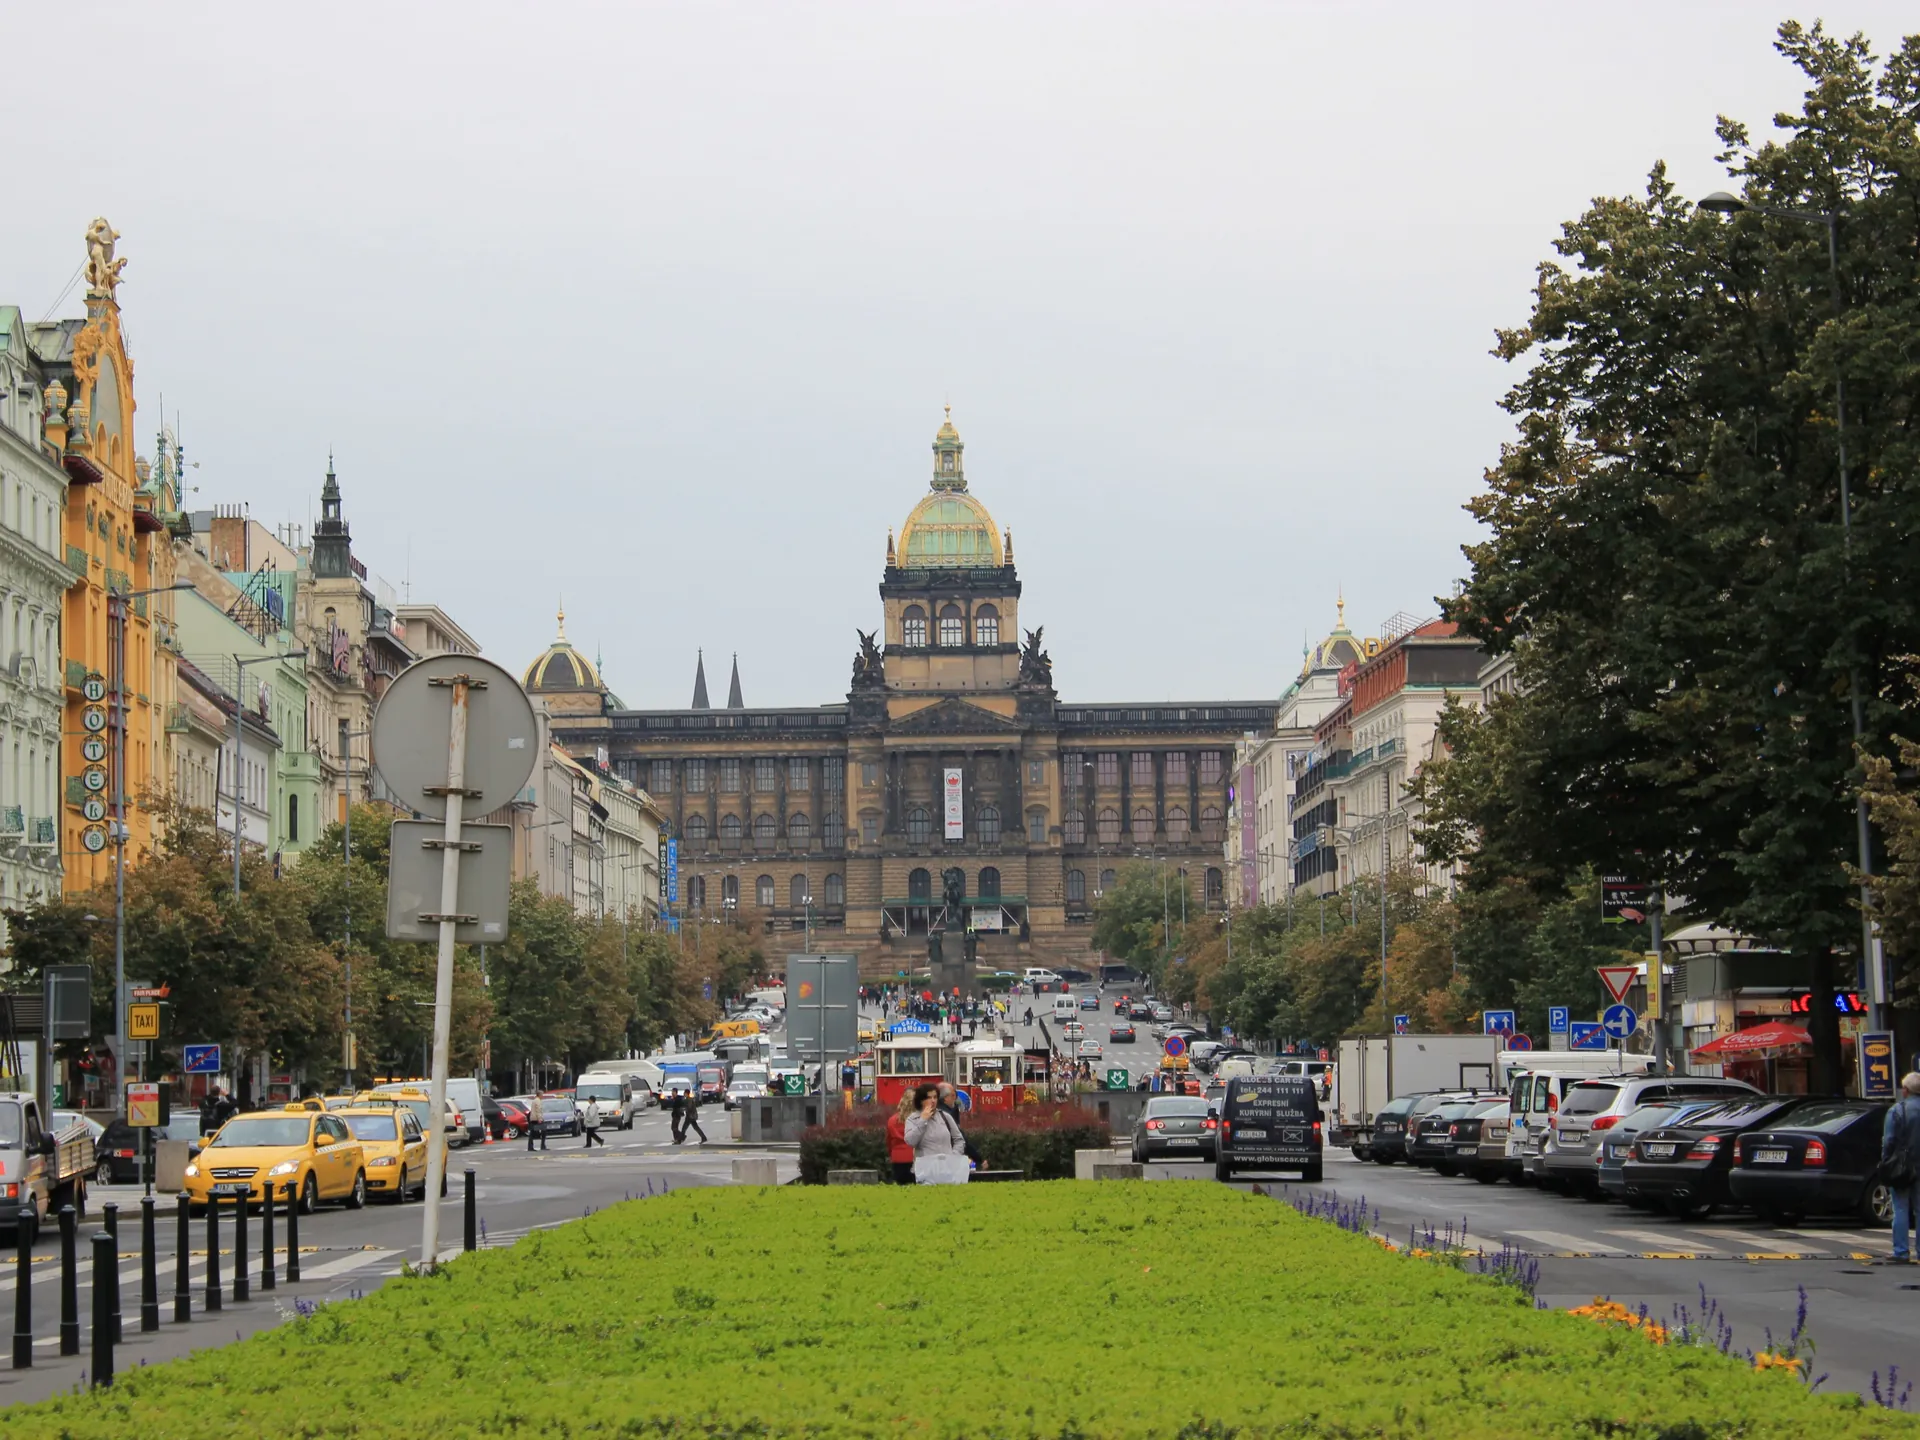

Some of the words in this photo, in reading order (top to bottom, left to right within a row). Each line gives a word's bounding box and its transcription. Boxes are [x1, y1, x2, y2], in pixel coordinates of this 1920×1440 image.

[89, 684, 99, 819] HOTEL
[135, 1015, 153, 1028] TAXI
[1552, 1009, 1564, 1025] P
[893, 1025, 927, 1033] TRAMVAJ
[884, 1032, 891, 1041] 11
[1724, 1032, 1782, 1045] Coca-Cola
[1253, 1099, 1289, 1107] EXPRESNÍ
[1233, 1155, 1309, 1163] www.globuscar.cz
